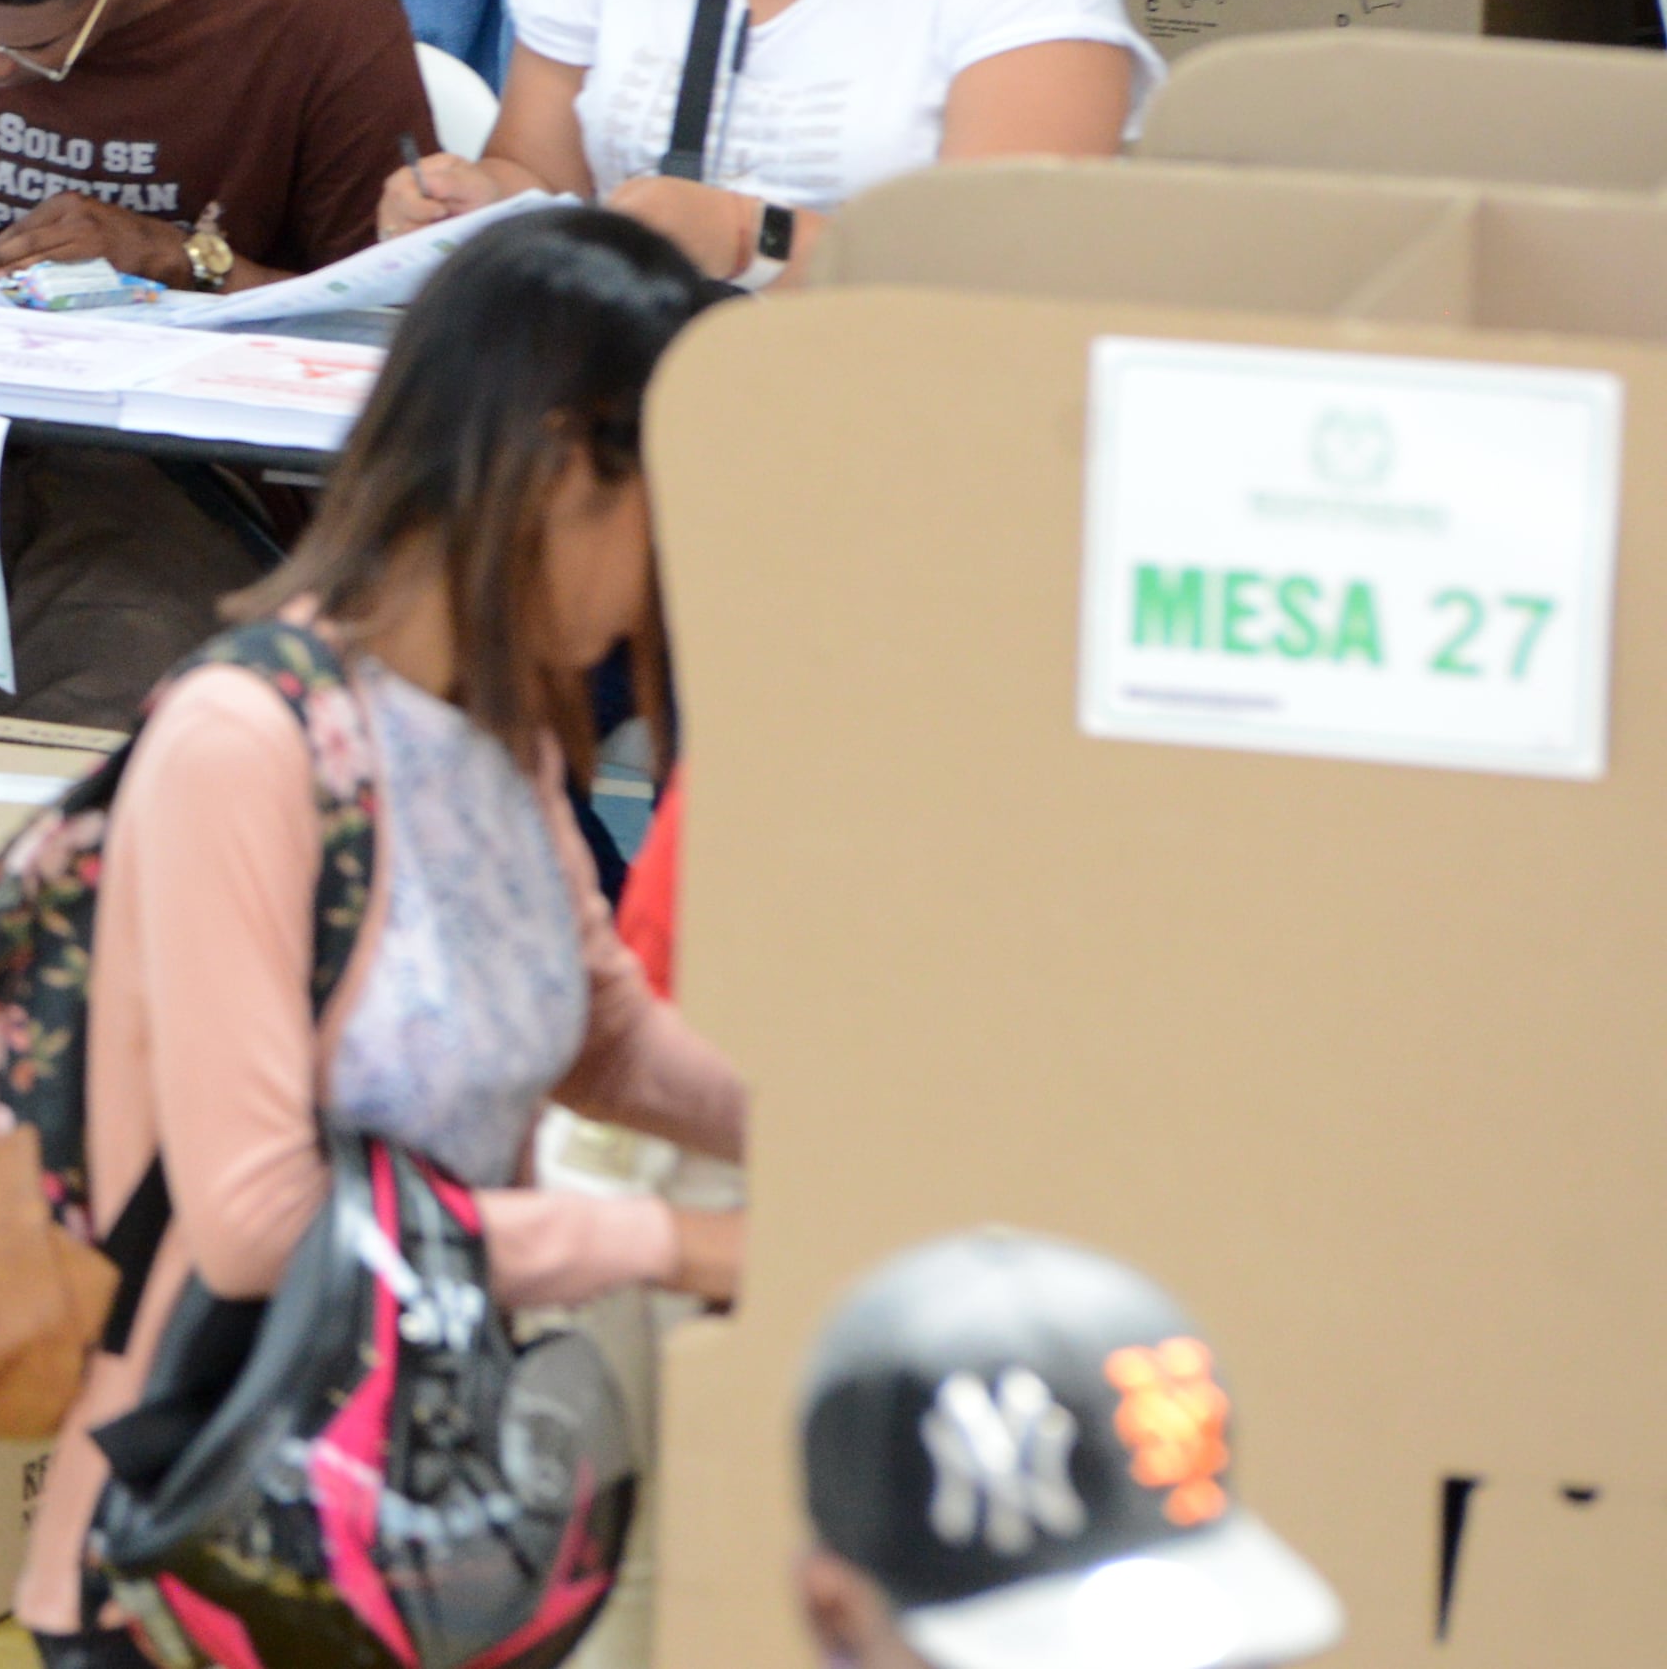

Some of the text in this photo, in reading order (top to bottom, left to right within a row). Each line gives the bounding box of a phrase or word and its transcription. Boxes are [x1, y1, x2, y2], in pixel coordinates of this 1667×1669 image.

[103, 141, 158, 175] SE
[1131, 561, 1557, 680] MESA 27
